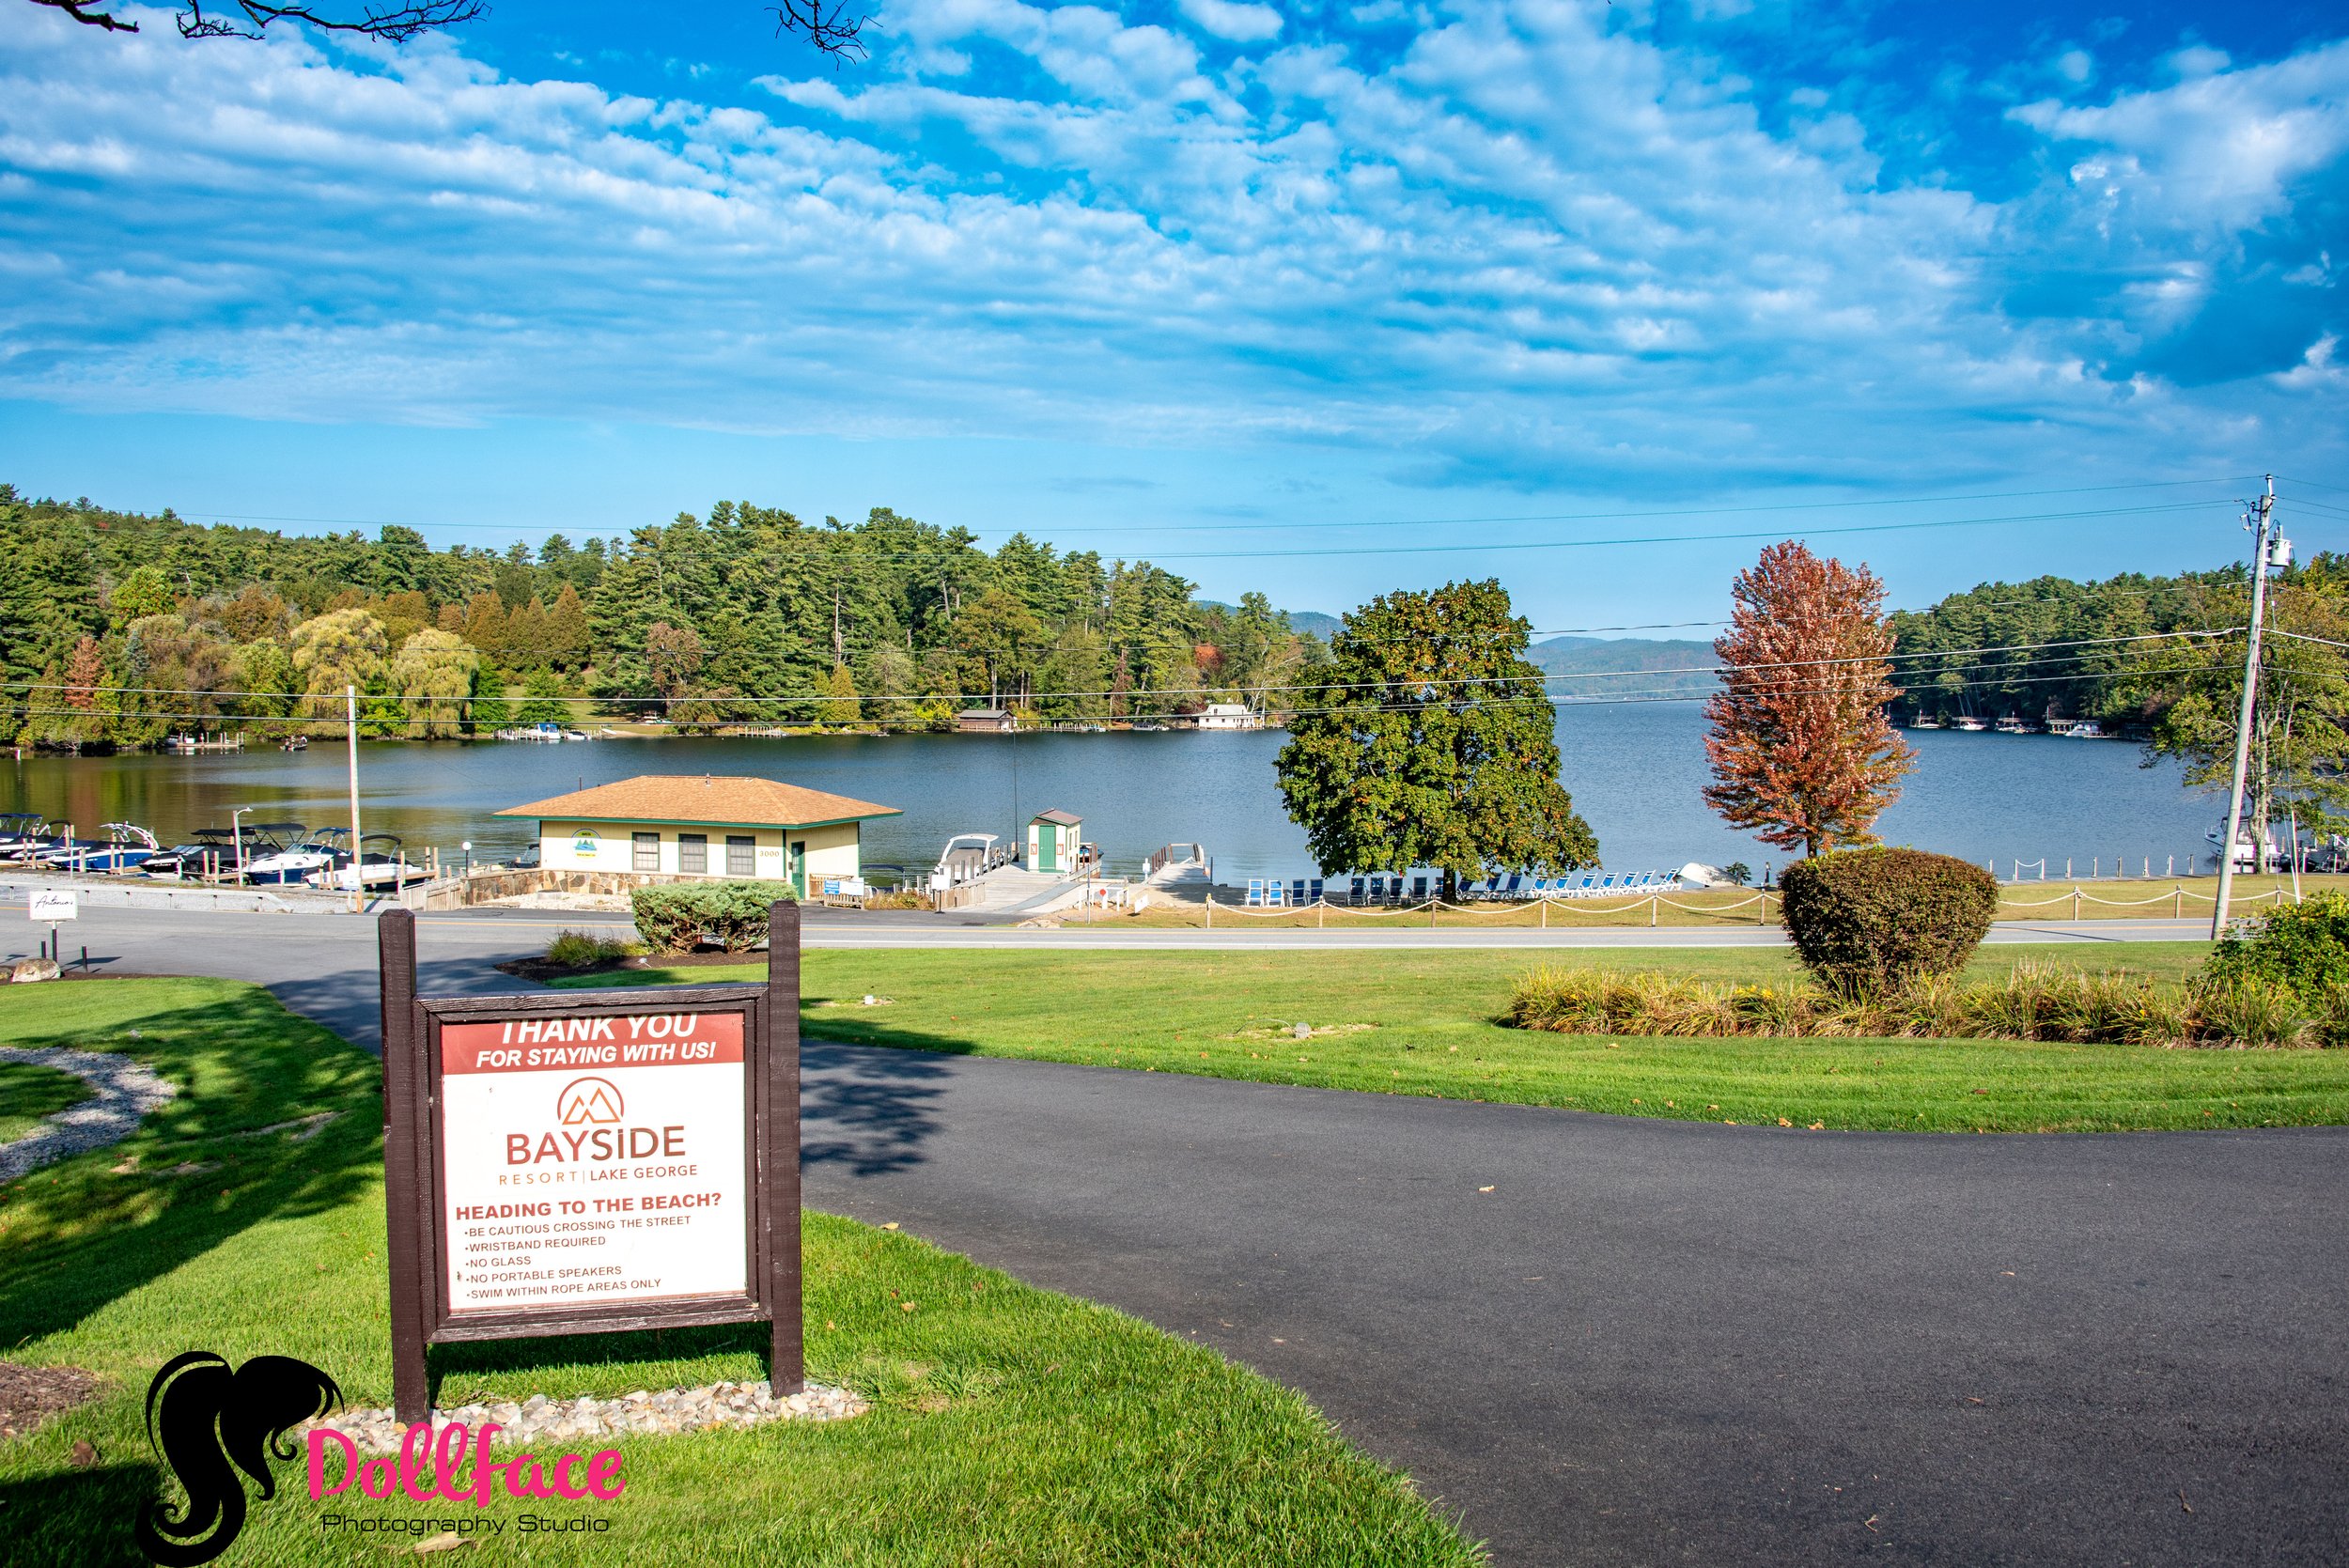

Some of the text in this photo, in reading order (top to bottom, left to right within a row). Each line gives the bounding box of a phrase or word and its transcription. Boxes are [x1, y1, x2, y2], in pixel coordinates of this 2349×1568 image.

[500, 1013, 697, 1045] THANK YOU
[475, 1041, 717, 1068] FOR STAYING WITH US!
[499, 1164, 698, 1186] RESORT LAKE GEORGE
[456, 1192, 723, 1221] HEADING TO THE BEACH?
[469, 1215, 692, 1237] BE CAUTIOUS CROSSING THE STREET
[469, 1235, 606, 1253] WRISTBAND REQUIRED
[470, 1255, 532, 1268] NO GLASS
[470, 1265, 622, 1284] NO PORTABLE SPEAKERS
[471, 1278, 661, 1299] SWIM WITHIN ROPE AREAS ONLY
